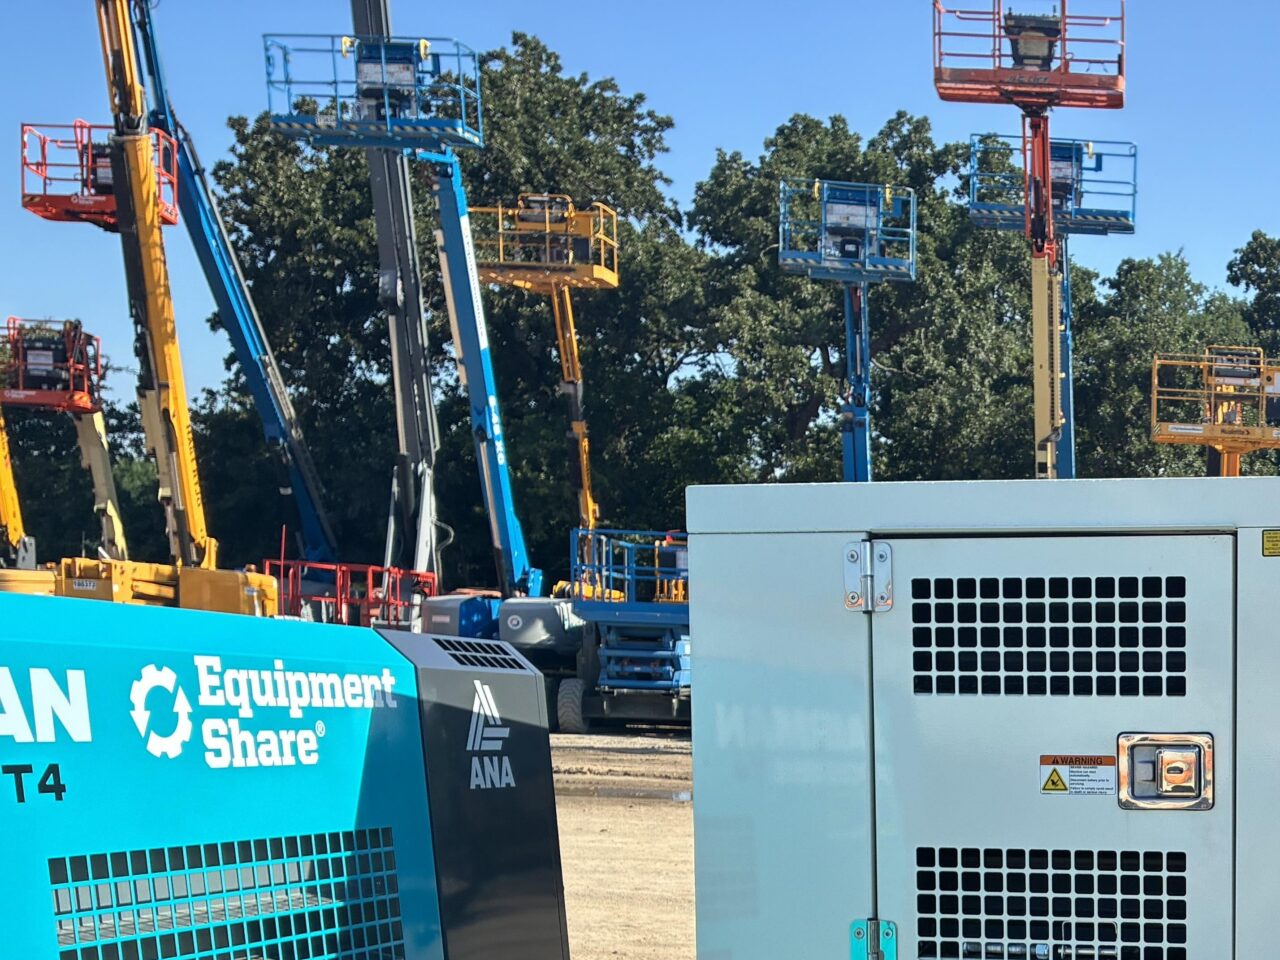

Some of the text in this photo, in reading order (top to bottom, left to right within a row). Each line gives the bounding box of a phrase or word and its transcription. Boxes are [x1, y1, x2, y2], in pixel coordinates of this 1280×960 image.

[193, 655, 398, 718] Equipment
[470, 755, 516, 790] ANA
[1059, 756, 1103, 765] WARNING
[1, 763, 67, 804] T4
